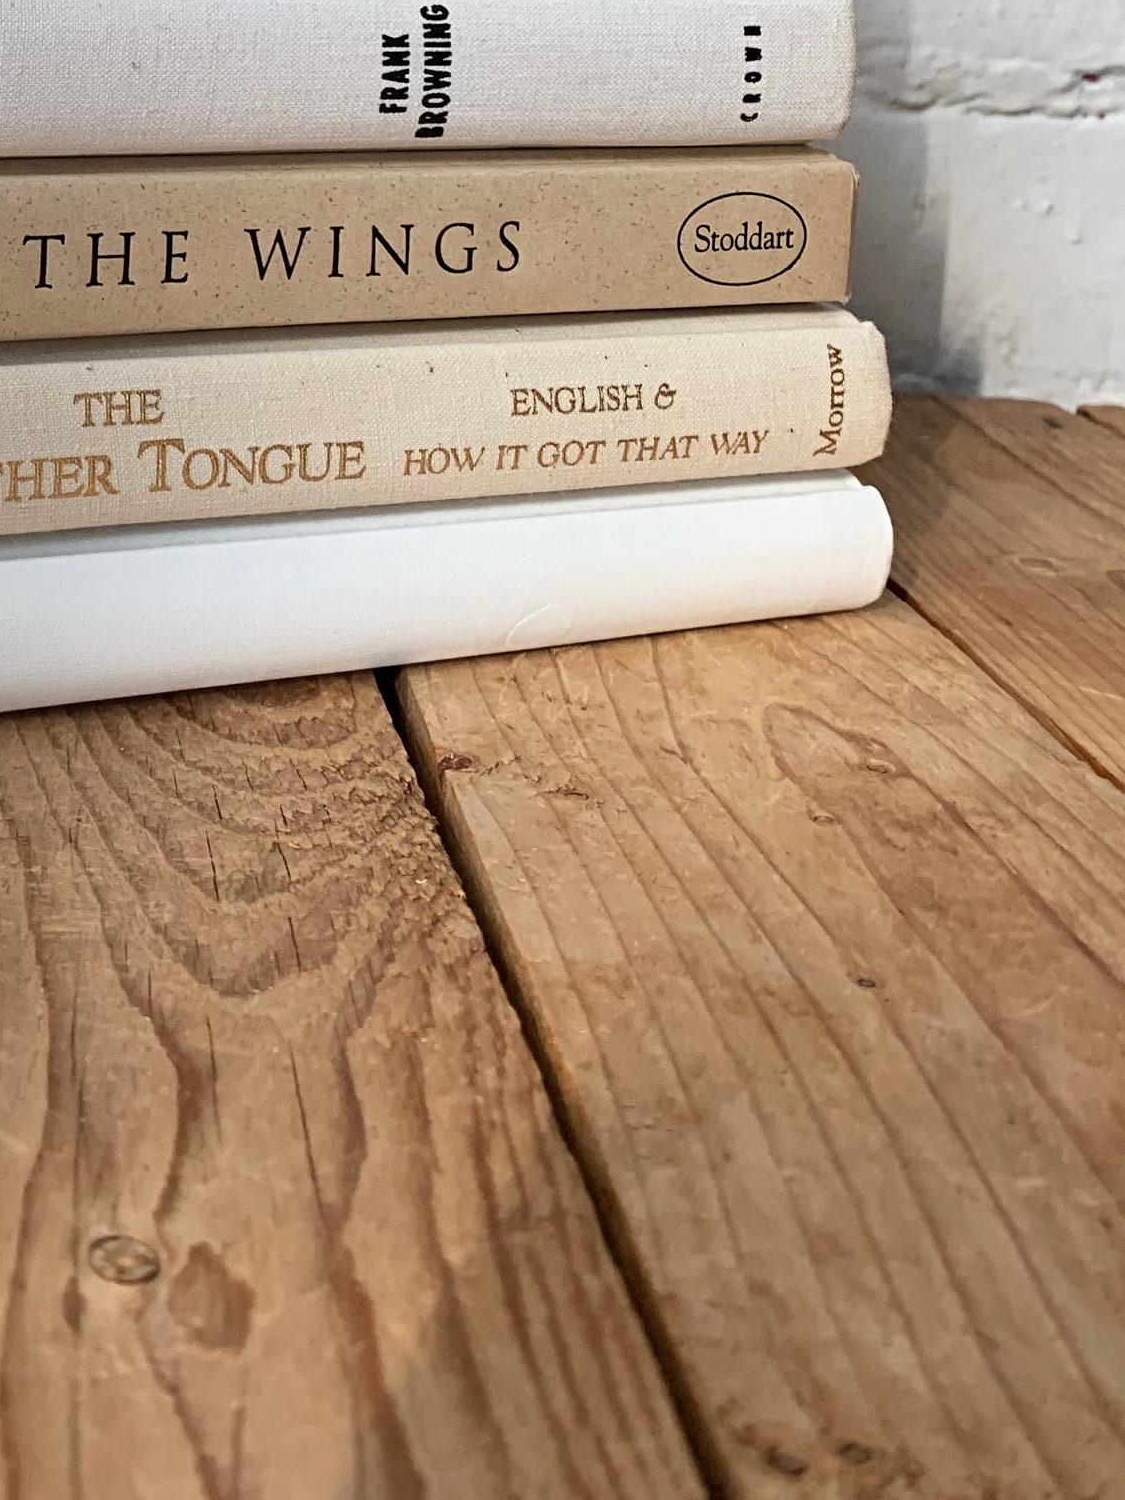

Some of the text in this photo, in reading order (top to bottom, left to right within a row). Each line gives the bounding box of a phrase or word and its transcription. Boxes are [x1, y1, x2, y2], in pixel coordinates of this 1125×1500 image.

[379, 34, 410, 113] FRANK
[415, 5, 452, 138] BROWNING
[740, 26, 762, 122] CROWN
[23, 231, 188, 289] THE
[244, 221, 519, 280] WINGS
[694, 221, 794, 253] Stoddart
[73, 389, 164, 427] THE
[510, 382, 677, 416] ENGLISH &
[813, 344, 845, 456] Morrow
[137, 438, 366, 493] TONGUE
[404, 430, 769, 476] HOW IT GOT THAT WAY
